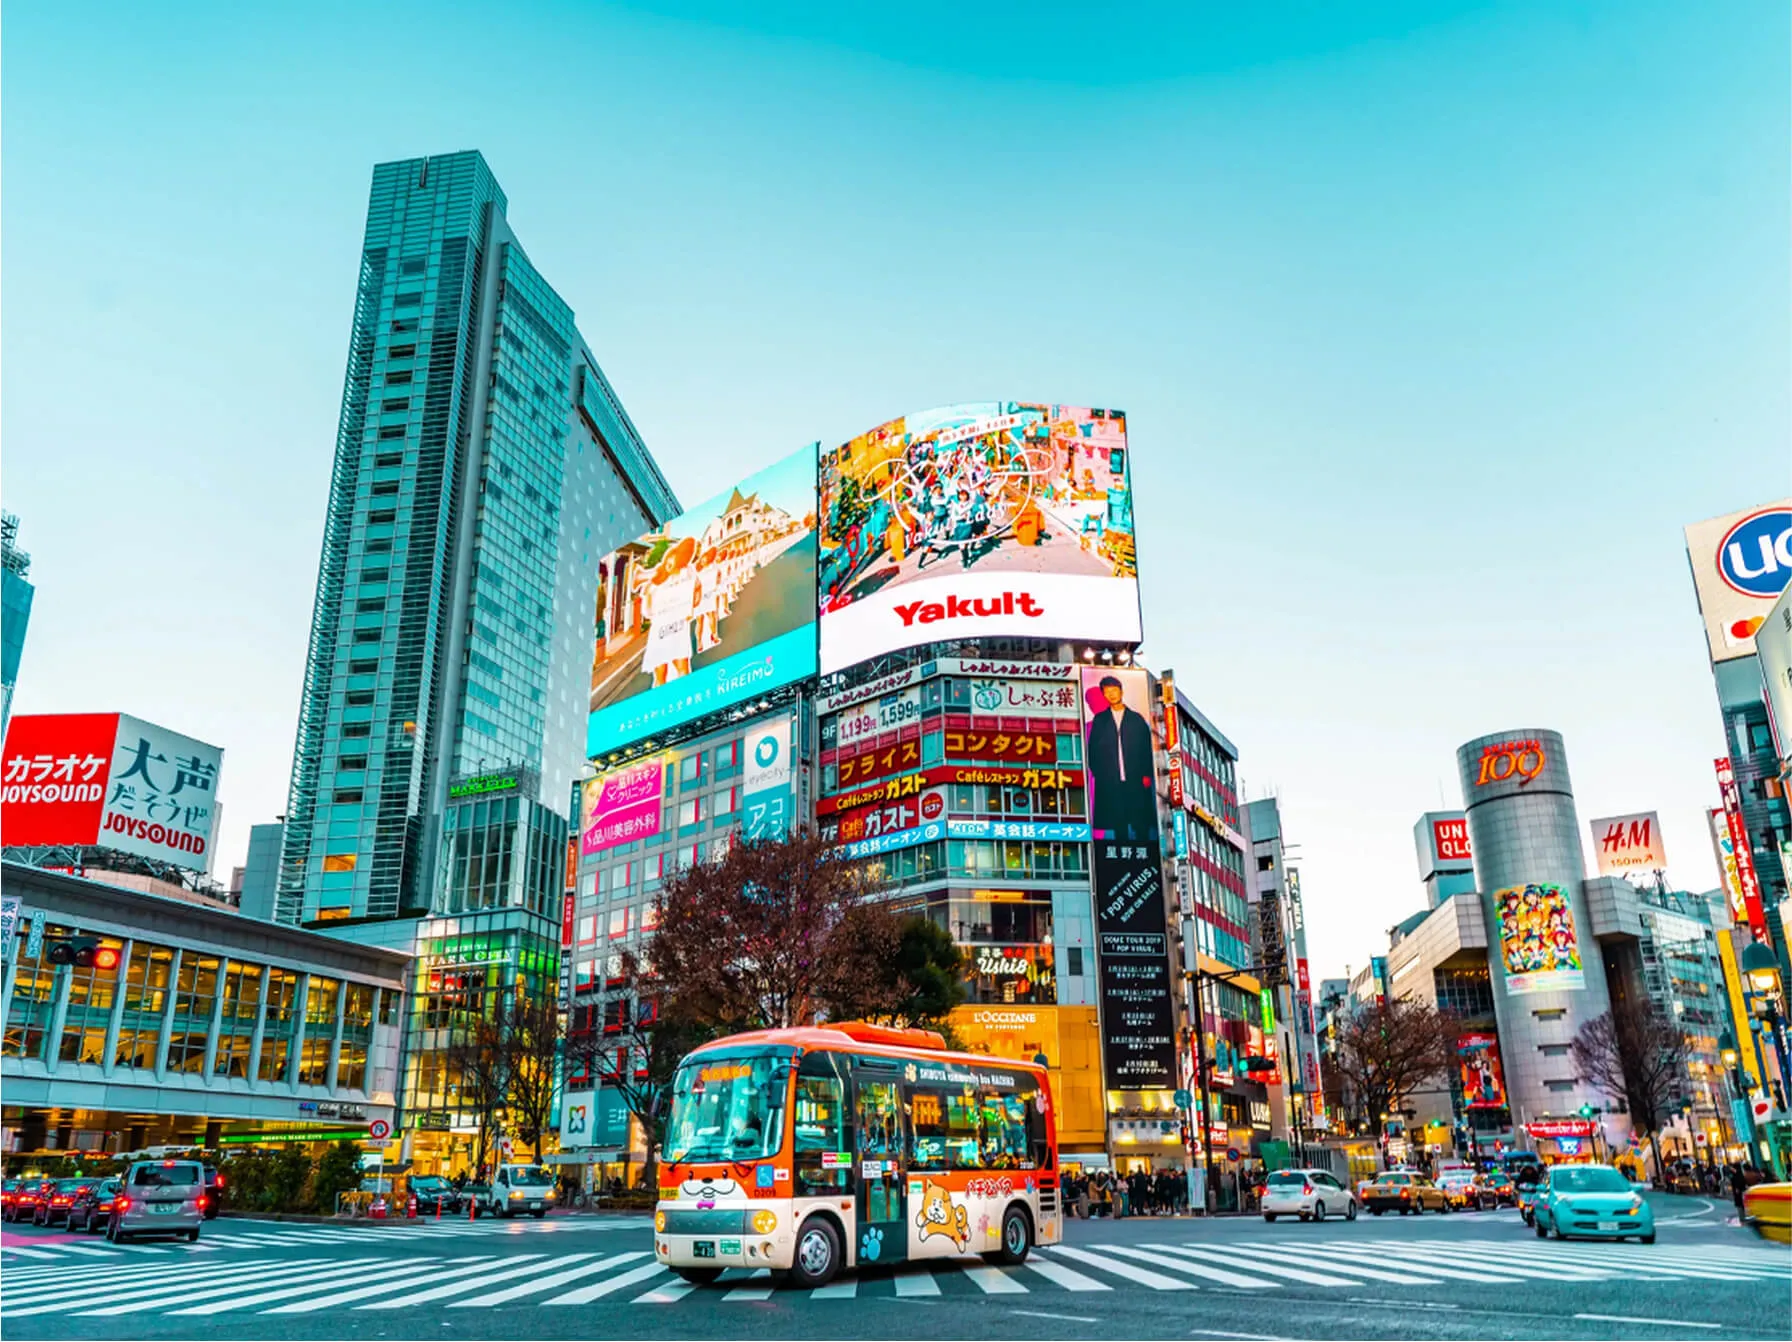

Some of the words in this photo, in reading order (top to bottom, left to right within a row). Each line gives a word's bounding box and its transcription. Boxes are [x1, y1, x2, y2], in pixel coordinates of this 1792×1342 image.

[893, 592, 1044, 627] Yakult
[717, 661, 775, 695] KIREIMO
[960, 660, 1073, 678] しゃぶしゃぶバイキング
[1008, 685, 1075, 708] しゃぶ葉
[822, 725, 837, 740] 9F
[945, 733, 1052, 756] コンタクト
[4, 753, 106, 782] カラオケ
[114, 738, 217, 796] 大声
[840, 742, 919, 782] プライス
[1475, 748, 1546, 788] 109
[1, 783, 103, 804] JOYSOUND
[103, 811, 206, 855] JOYSOUND
[865, 805, 915, 838] ガスト
[993, 823, 1088, 838] 英会話イーオン
[1602, 818, 1650, 853] H&M
